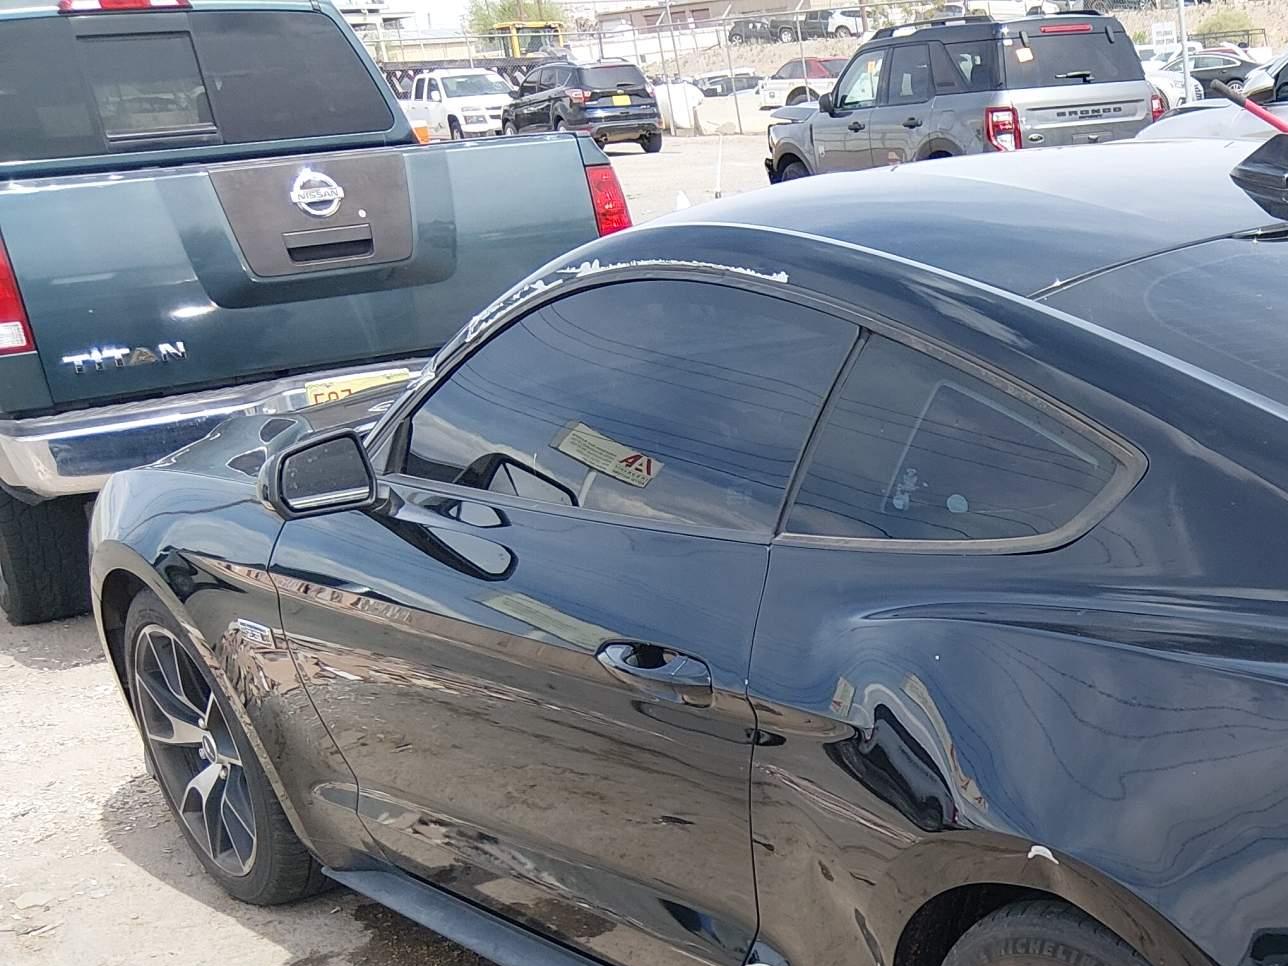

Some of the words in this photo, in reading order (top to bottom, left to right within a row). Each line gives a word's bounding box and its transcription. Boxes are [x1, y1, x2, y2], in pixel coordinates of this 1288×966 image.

[1056, 106, 1122, 117] BRONCO
[297, 189, 339, 201] NISSAN
[61, 341, 187, 375] TITAN
